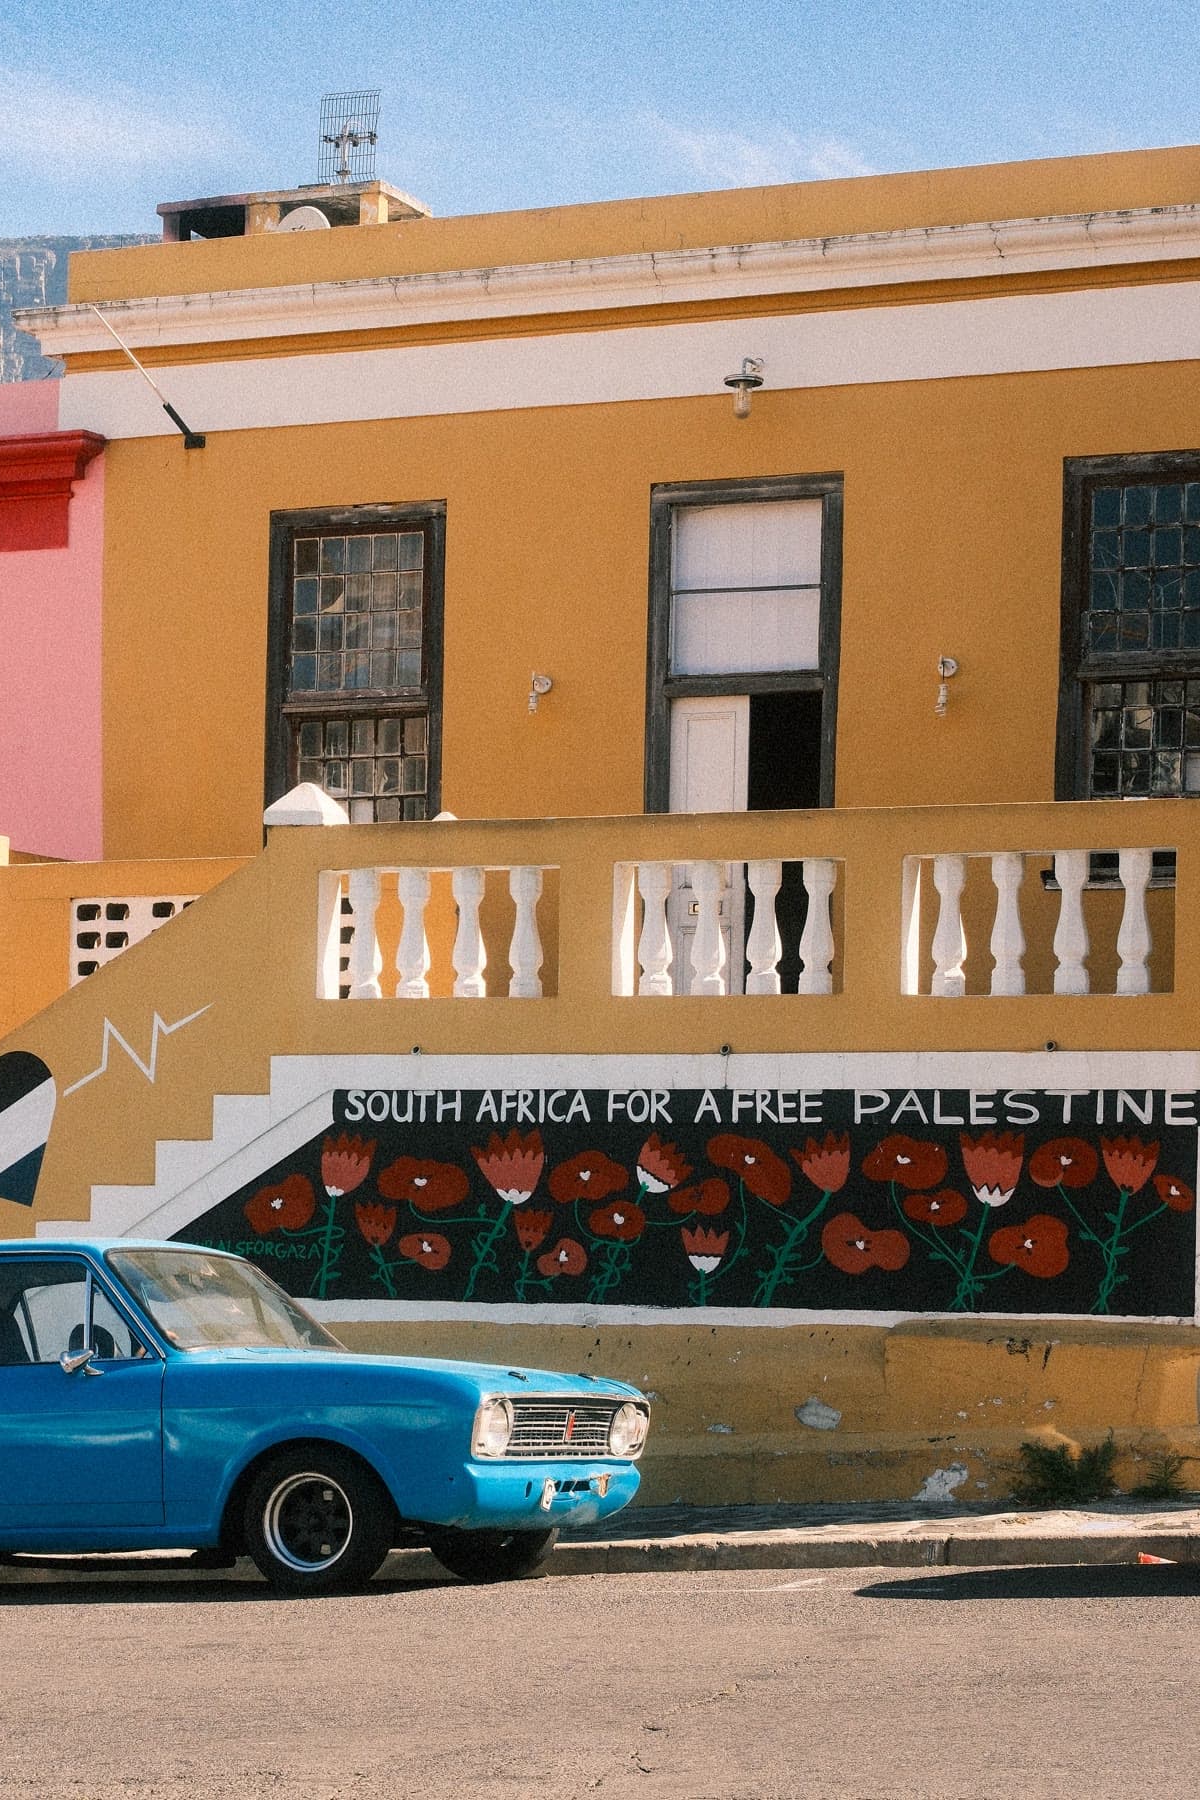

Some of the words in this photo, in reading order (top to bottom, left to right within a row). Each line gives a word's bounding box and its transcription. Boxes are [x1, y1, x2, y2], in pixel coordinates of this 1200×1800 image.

[344, 1090, 461, 1122] SOUTH
[476, 1090, 590, 1123] AFRICA
[607, 1090, 672, 1123] FOR
[694, 1090, 722, 1124] A
[731, 1090, 823, 1123] FREE
[855, 1090, 1198, 1125] PALESTINE
